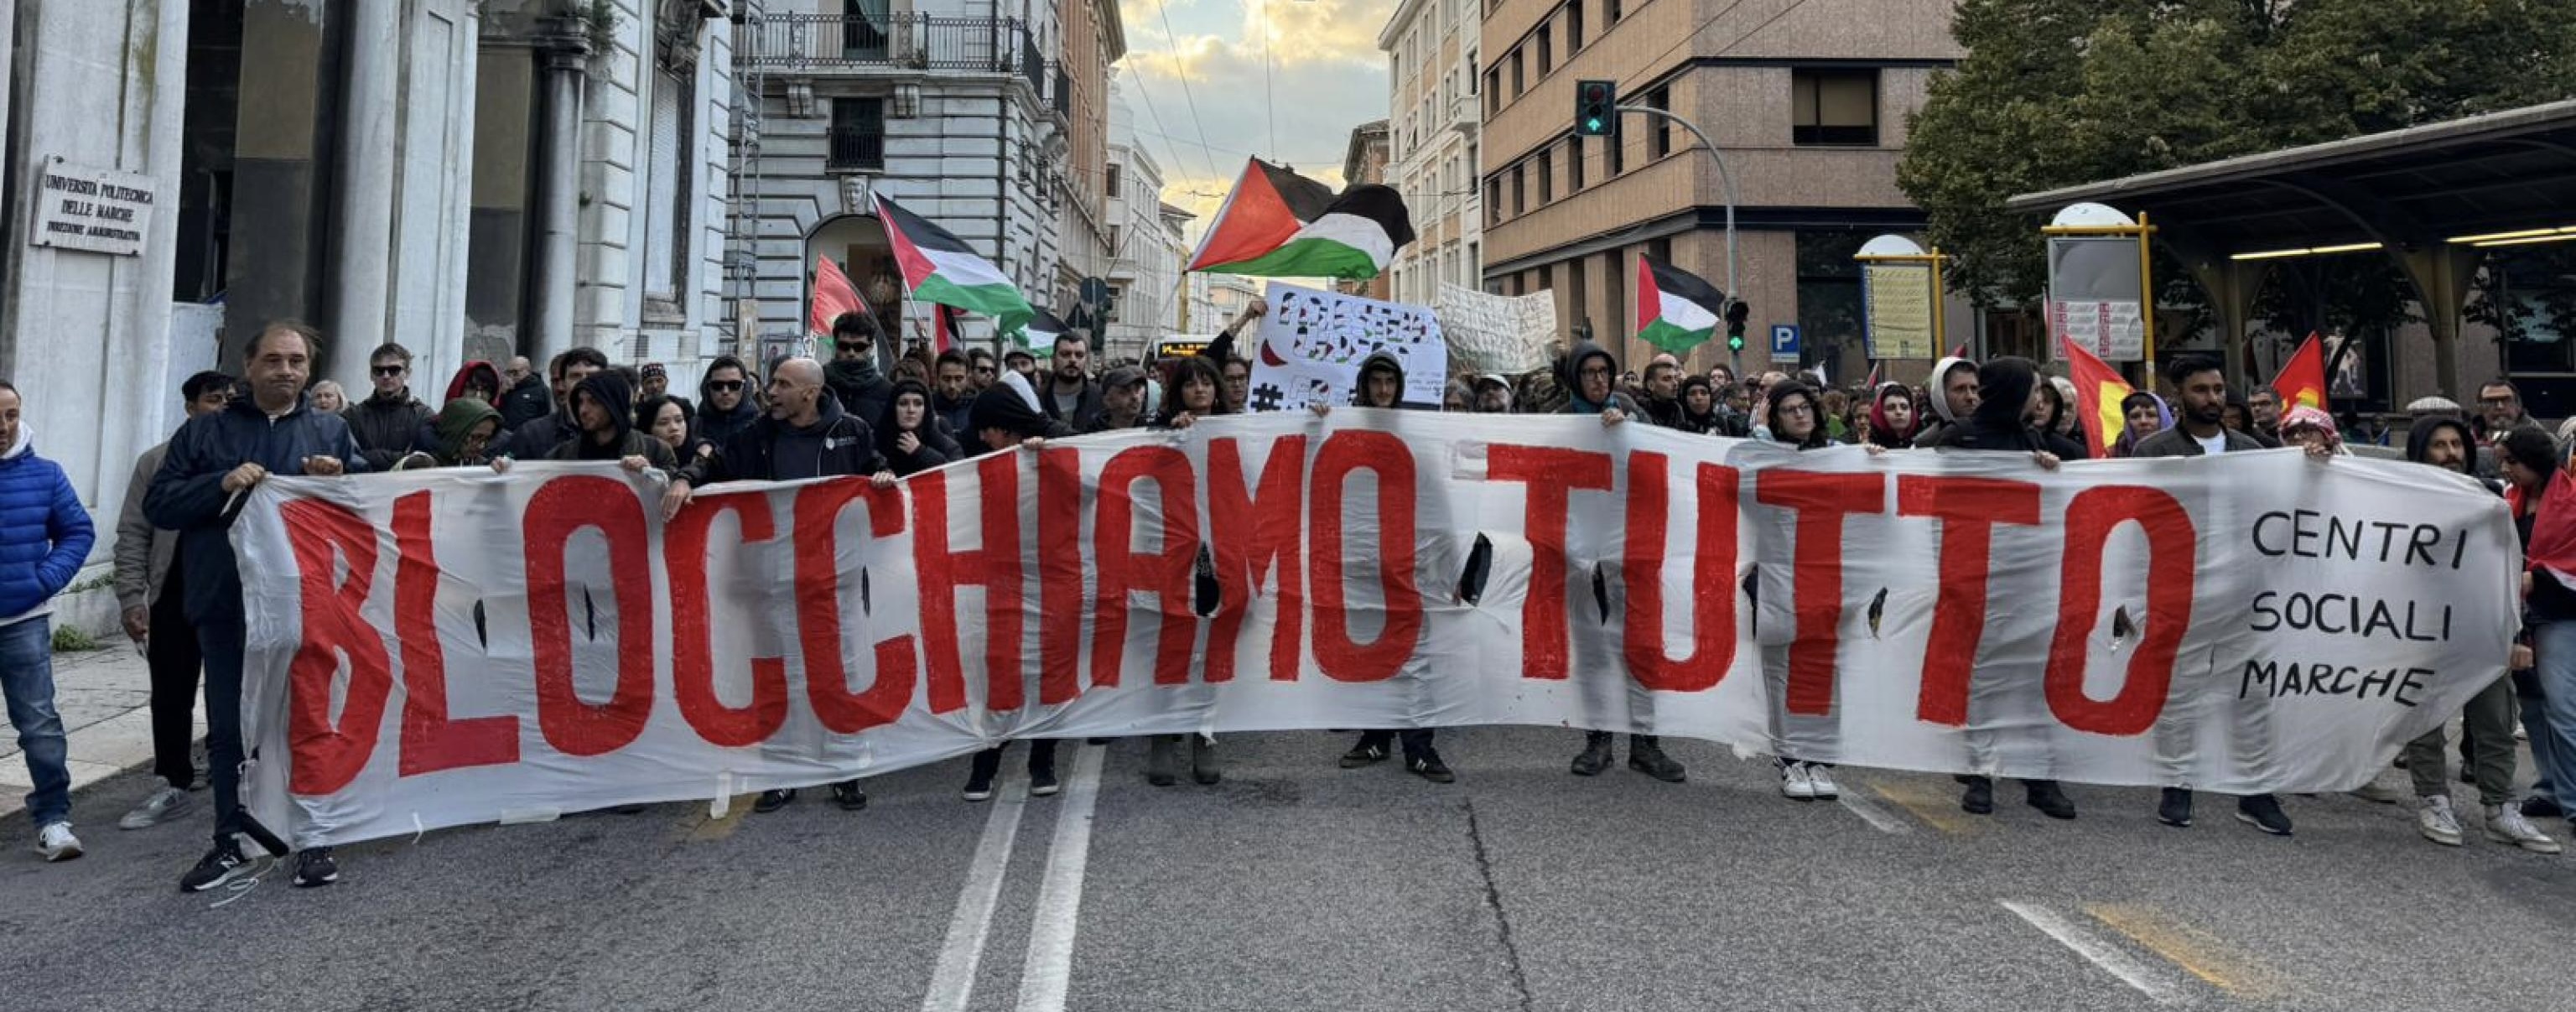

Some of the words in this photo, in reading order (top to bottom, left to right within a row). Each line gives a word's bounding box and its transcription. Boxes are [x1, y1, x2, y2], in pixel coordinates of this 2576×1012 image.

[61, 199, 94, 217] DELLE
[96, 203, 135, 222] MARCHE
[1777, 327, 1794, 350] P
[2251, 509, 2467, 570] CENTRI
[283, 431, 1420, 795] BLOCCHIAMO
[1487, 444, 2195, 735] TUTTO
[2250, 591, 2451, 641] SOCIALI
[2239, 659, 2435, 708] MARCHE
